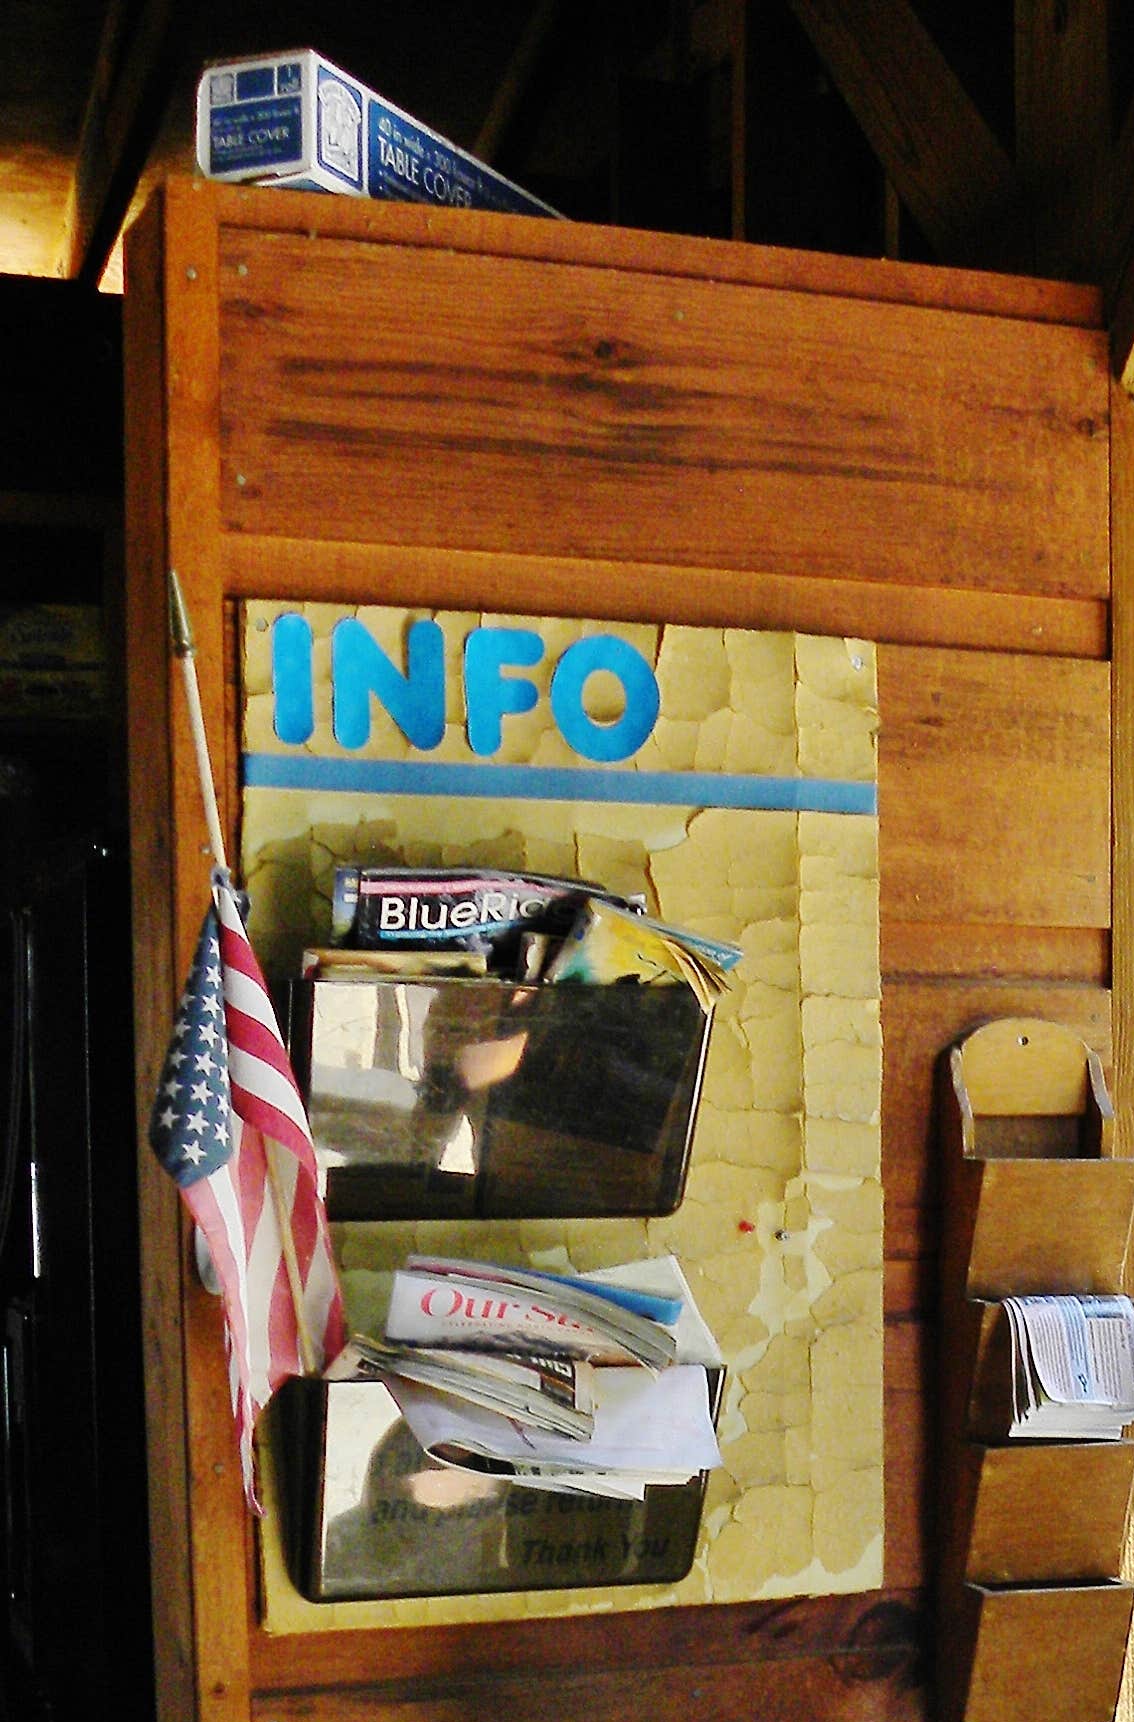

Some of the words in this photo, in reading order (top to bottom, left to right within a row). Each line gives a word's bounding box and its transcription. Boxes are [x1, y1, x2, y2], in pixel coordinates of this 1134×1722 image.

[248, 126, 289, 144] COVER
[378, 136, 419, 185] TABLE
[423, 167, 472, 208] COVER
[272, 611, 661, 764] INFO
[420, 1288, 519, 1319] Our
